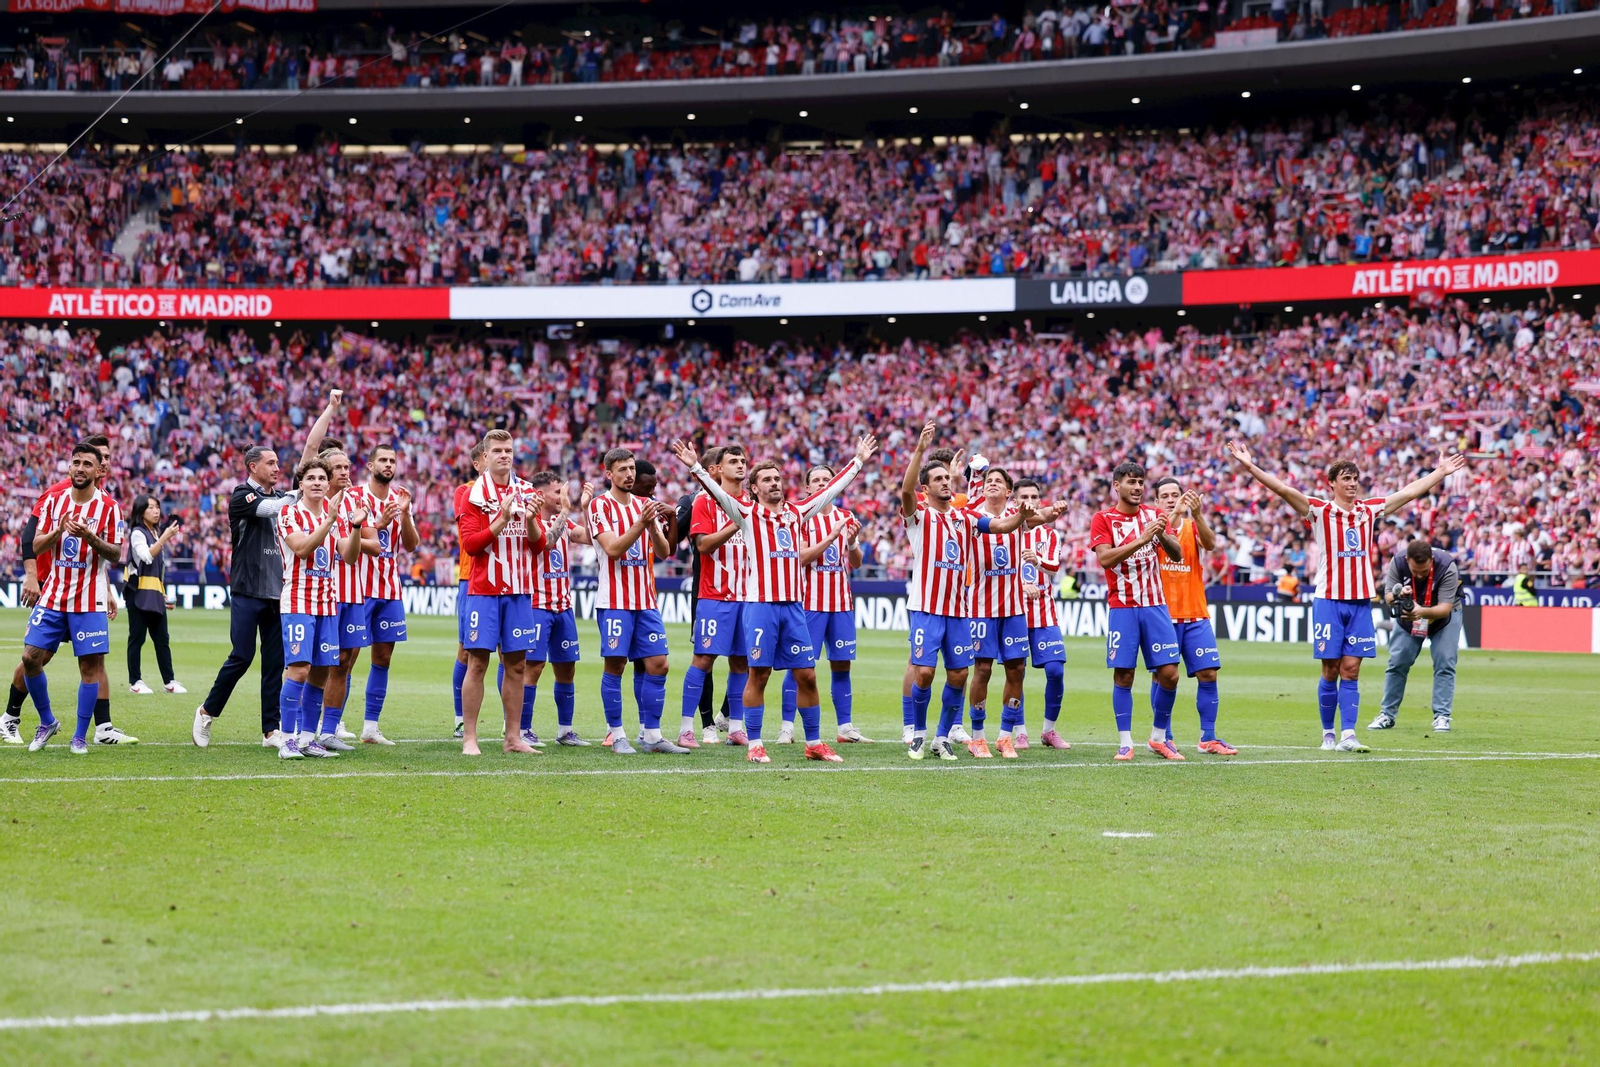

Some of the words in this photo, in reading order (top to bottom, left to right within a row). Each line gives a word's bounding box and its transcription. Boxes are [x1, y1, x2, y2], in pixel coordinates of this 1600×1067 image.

[1352, 262, 1449, 294] ATLÉTICO
[1473, 259, 1559, 288] MADRID
[719, 294, 781, 308] ComAve
[1050, 280, 1122, 304] LALIGA
[48, 289, 155, 316] ATLÉTICO
[180, 295, 273, 316] MADRID
[935, 561, 953, 569] RIYADH
[470, 611, 479, 628] 9
[606, 618, 622, 637] 15
[700, 619, 717, 636] 18
[1223, 604, 1305, 643] VISIT
[287, 624, 305, 642] 19
[754, 628, 764, 646] 7
[915, 628, 924, 645] 6
[970, 621, 987, 639] 20
[1315, 623, 1331, 640] 24
[1108, 631, 1120, 648] 12
